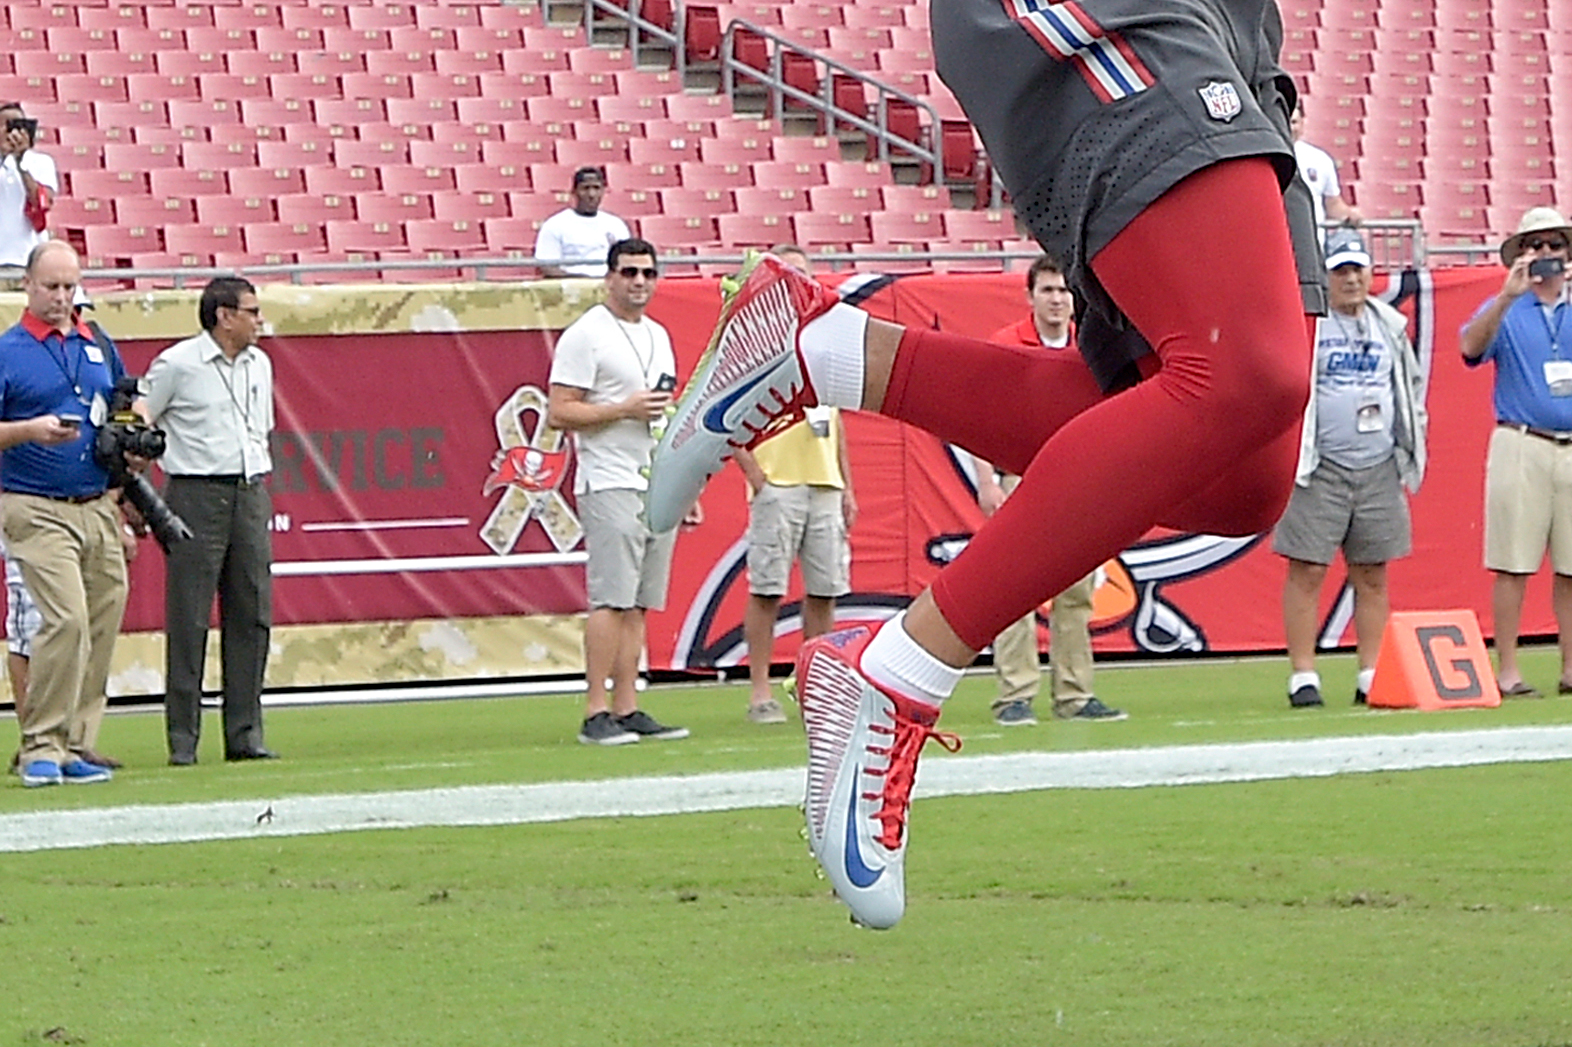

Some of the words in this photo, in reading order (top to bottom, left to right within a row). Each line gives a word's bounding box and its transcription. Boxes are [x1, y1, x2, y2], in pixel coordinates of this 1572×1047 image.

[1211, 95, 1239, 114] NFL
[271, 427, 445, 493] RVICE
[1414, 624, 1483, 701] G
